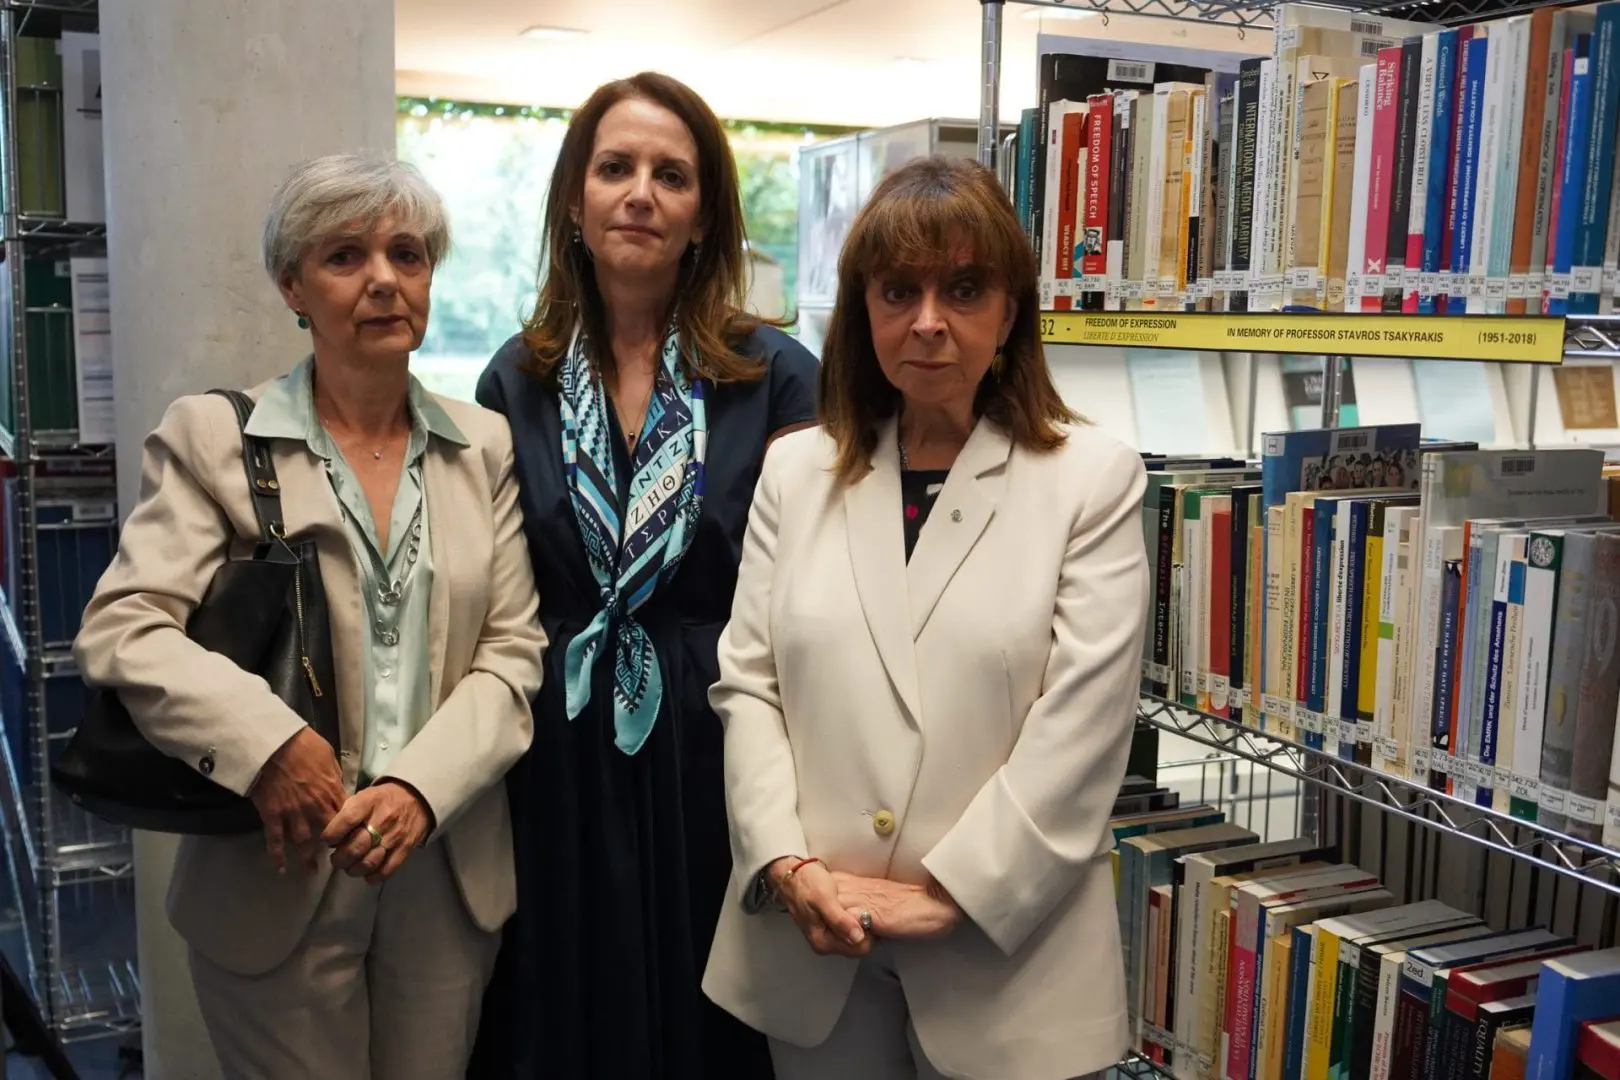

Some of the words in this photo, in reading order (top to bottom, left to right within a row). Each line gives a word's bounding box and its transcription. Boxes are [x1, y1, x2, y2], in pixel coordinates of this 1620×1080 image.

[1438, 46, 1449, 89] Contested
[1376, 69, 1386, 110] Balance
[1383, 62, 1396, 106] Striking
[1423, 67, 1432, 100] VIRTUE
[1421, 105, 1430, 124] LESS
[1436, 91, 1446, 116] Words
[1092, 114, 1101, 162] FREEDOM
[1242, 102, 1257, 178] INTERNATIONAL
[1091, 165, 1099, 178] OF
[1416, 128, 1428, 187] CLOISTERED
[1089, 181, 1098, 218] SPEECH
[1240, 182, 1253, 212] MEDIA
[1238, 216, 1251, 259] LIABILITY
[1085, 318, 1118, 327] FREEDOM
[1119, 318, 1128, 328] OF
[1130, 319, 1176, 329] EXPRESSION
[1227, 328, 1236, 337] IN
[1237, 328, 1271, 338] MEMORY
[1273, 329, 1284, 338] OF
[1285, 329, 1335, 340] PROFESSOR
[1338, 330, 1380, 341] STAVROS
[1383, 331, 1443, 343] TSAKYRAKIS
[1478, 332, 1536, 345] (1951-2018)
[1429, 585, 1438, 608] FREE
[1156, 602, 1165, 653] Internet
[1426, 611, 1436, 648] SPEECH
[1493, 611, 1503, 647] Ansehens
[1442, 660, 1448, 669] IN
[1491, 650, 1500, 664] des
[1489, 665, 1498, 690] Schutz
[1422, 680, 1432, 725] INTERNET
[1438, 696, 1446, 727] SPEECH
[1487, 705, 1495, 719] und
[1488, 692, 1496, 704] der
[1484, 721, 1494, 743] EMRK
[1483, 746, 1492, 756] Die
[1473, 1018, 1488, 1077] EQUALITY
